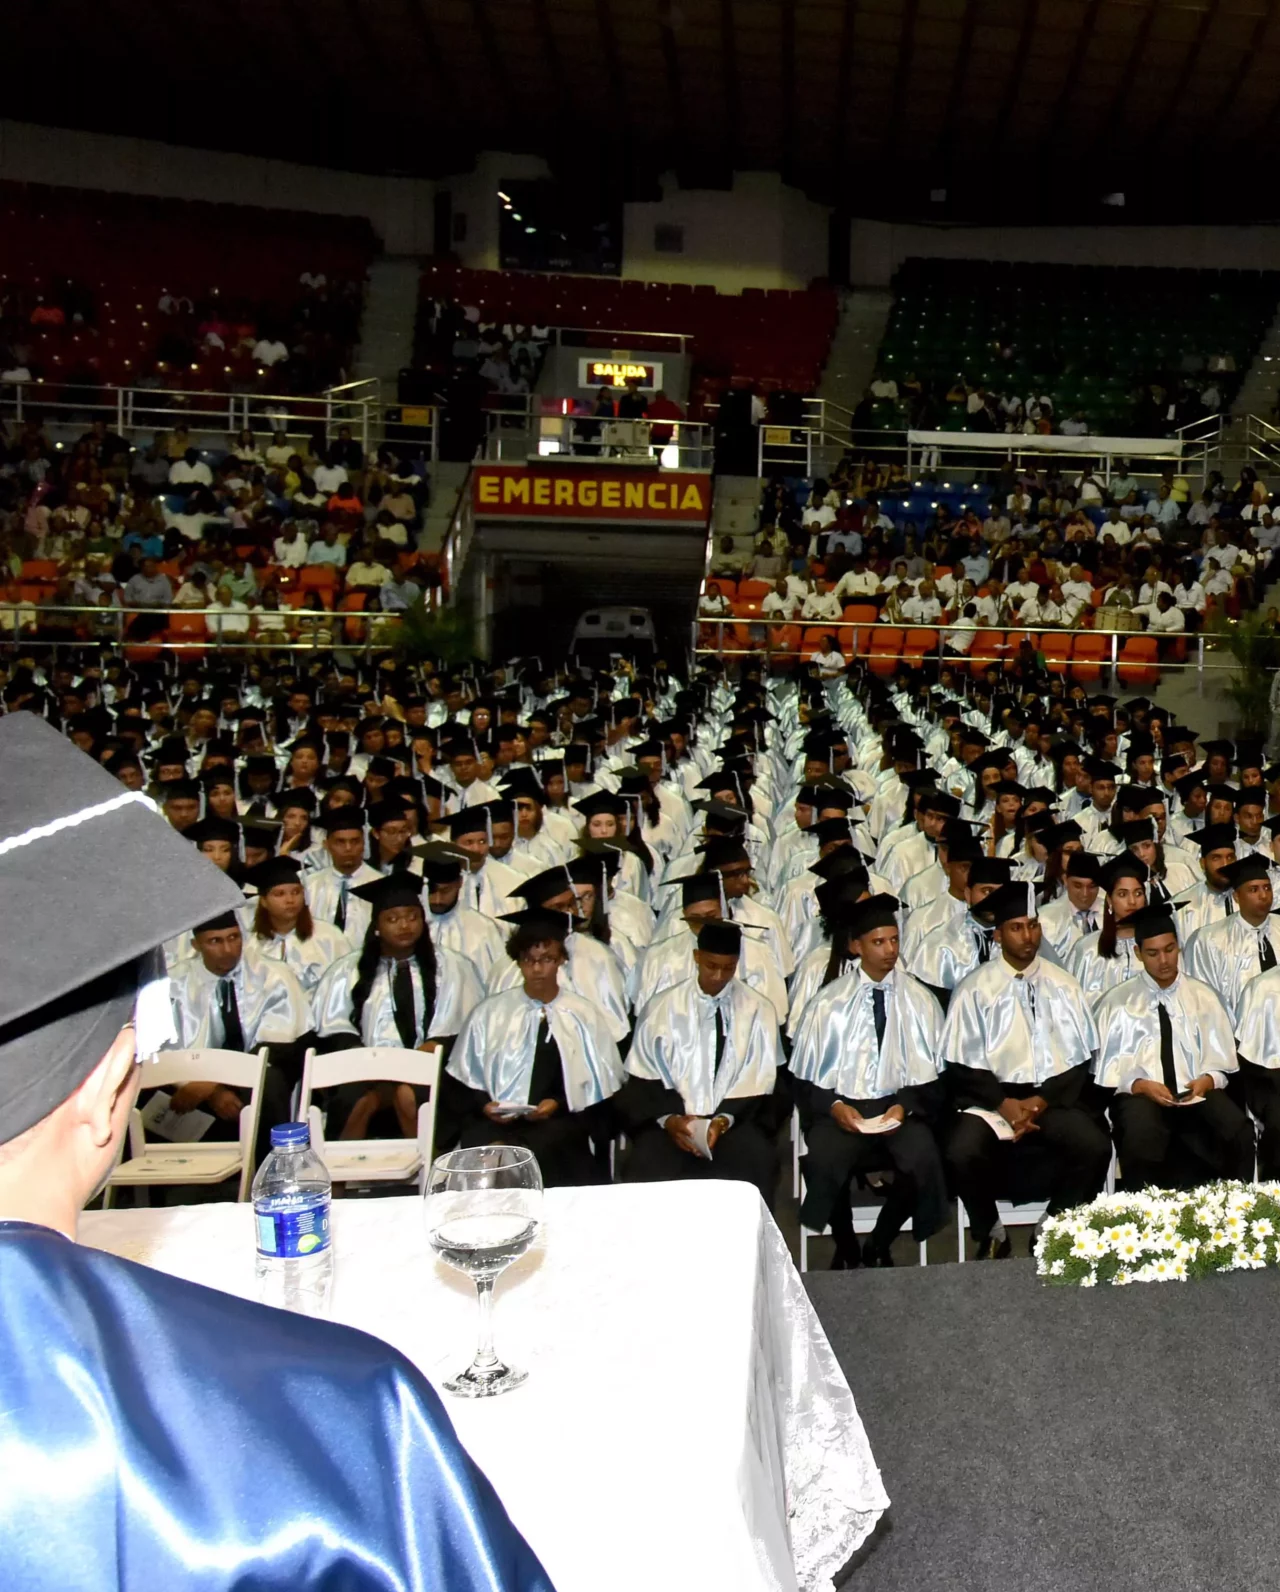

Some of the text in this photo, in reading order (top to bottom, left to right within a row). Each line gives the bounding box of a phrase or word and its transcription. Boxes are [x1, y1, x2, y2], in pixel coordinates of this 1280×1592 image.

[593, 363, 647, 377] SALIDA
[613, 376, 626, 387] K
[479, 476, 703, 510] EMERGENCIA
